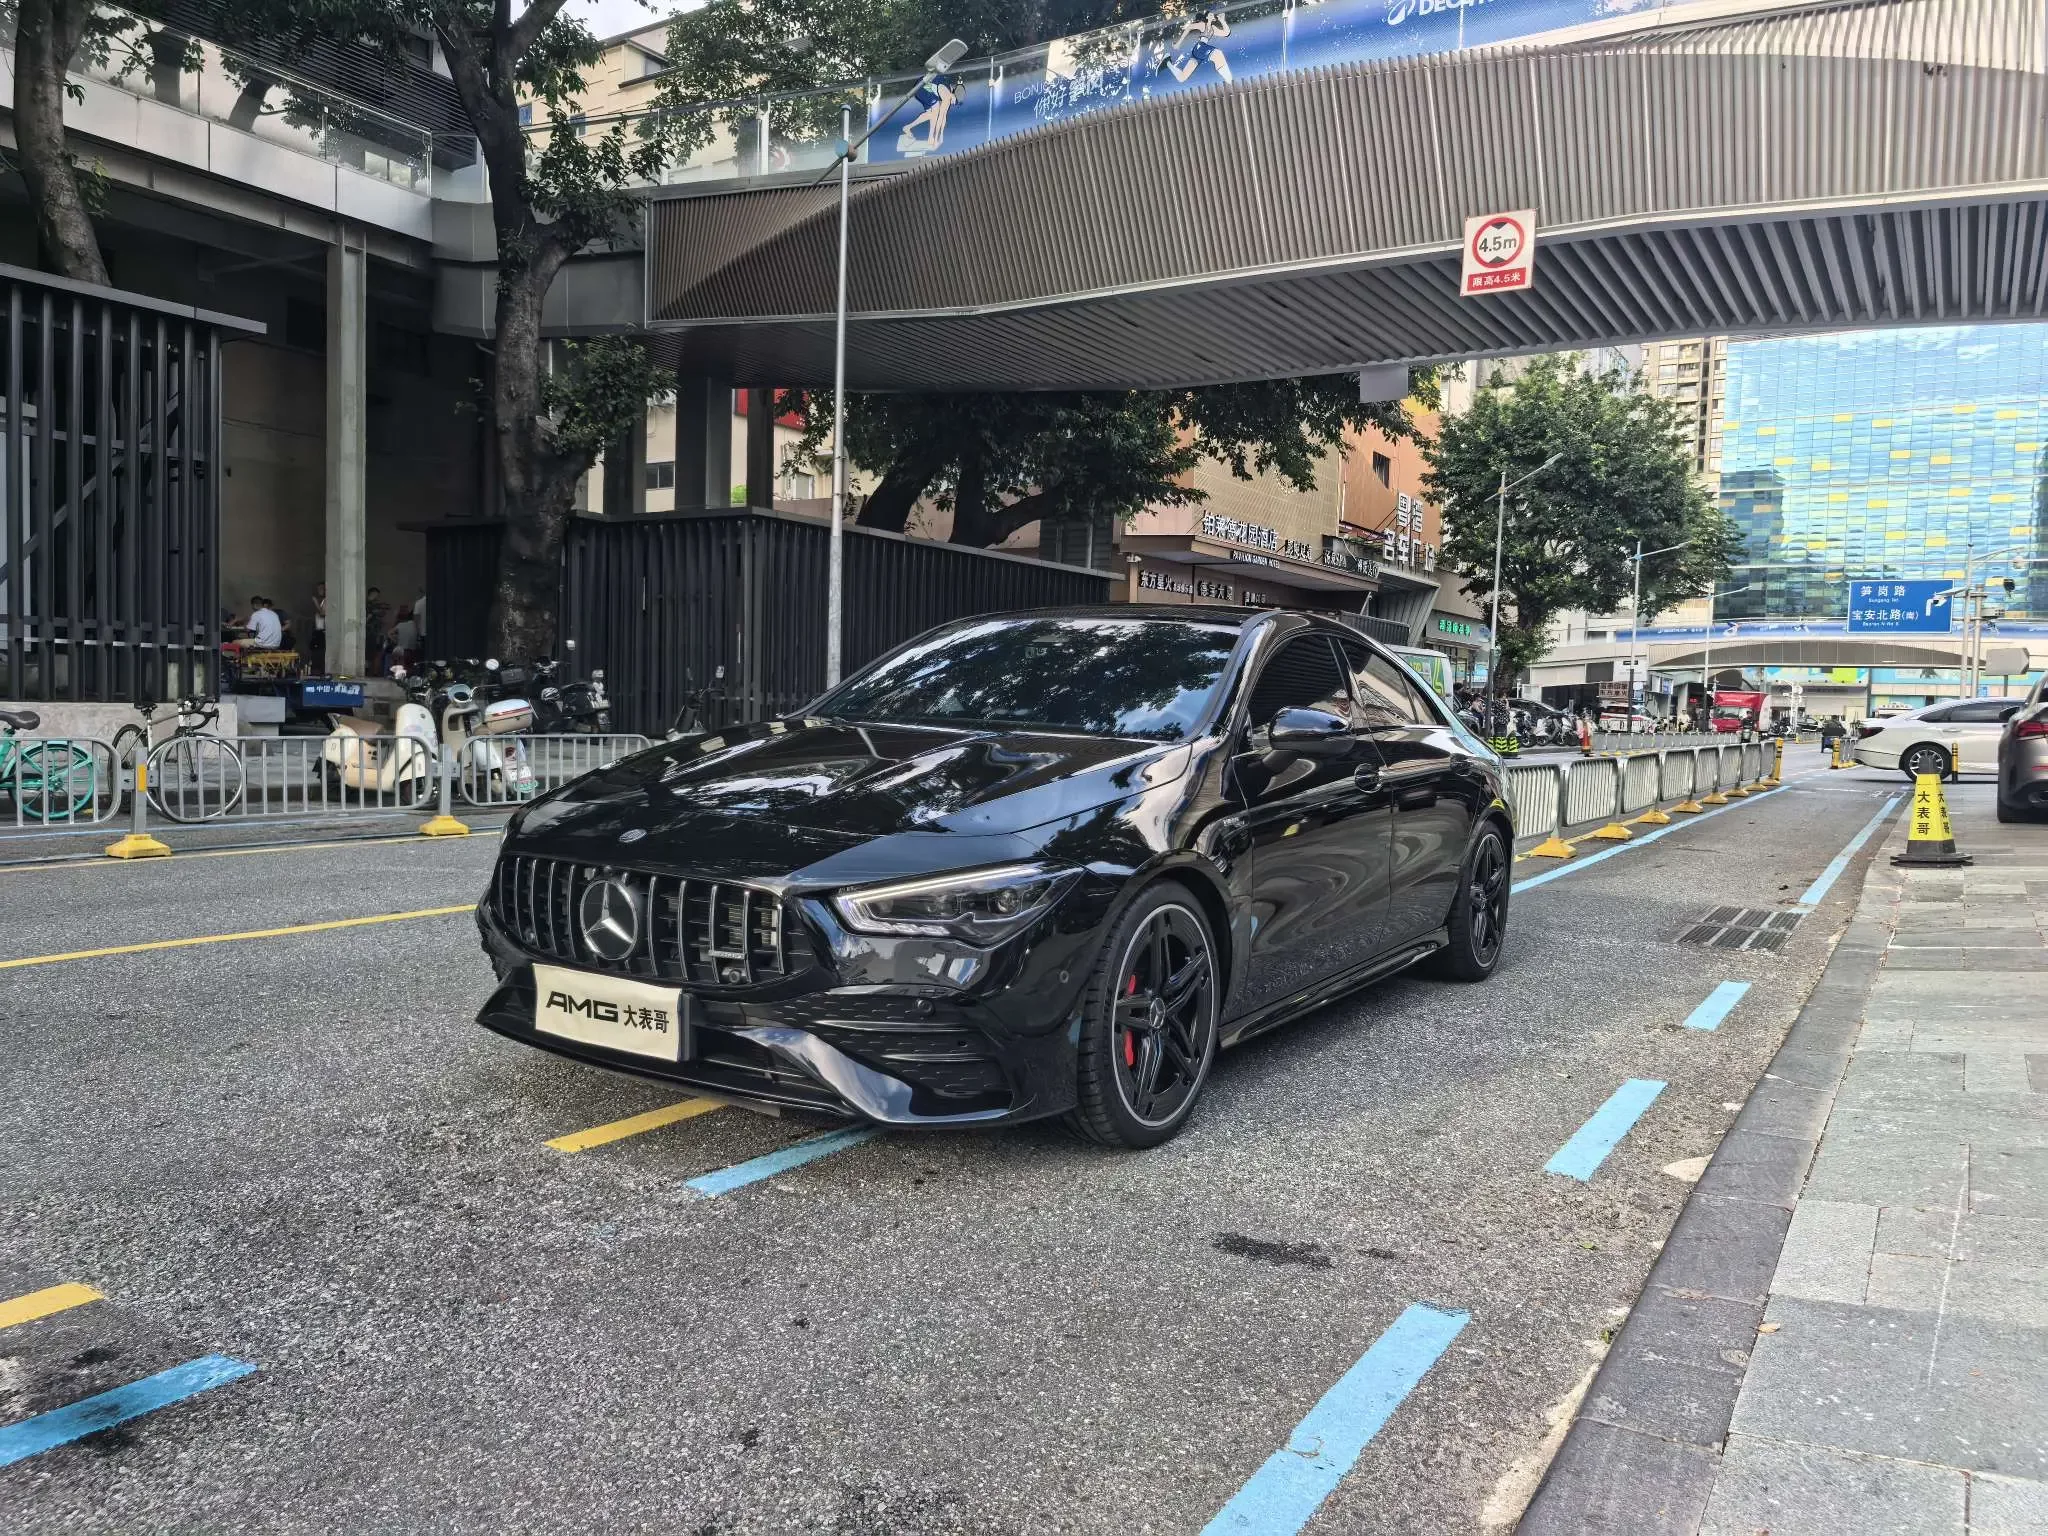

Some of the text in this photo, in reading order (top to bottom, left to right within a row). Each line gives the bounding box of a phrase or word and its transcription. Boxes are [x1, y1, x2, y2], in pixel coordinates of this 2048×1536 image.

[1479, 236, 1517, 252] 4.5m
[1472, 272, 1521, 287] 限高4.5米
[1140, 570, 1173, 592] 东方星火
[1860, 585, 1905, 597] 笋岗路
[1916, 790, 1931, 835] 大表哥
[545, 990, 619, 1023] AMG
[623, 1005, 670, 1034] 大表哥
